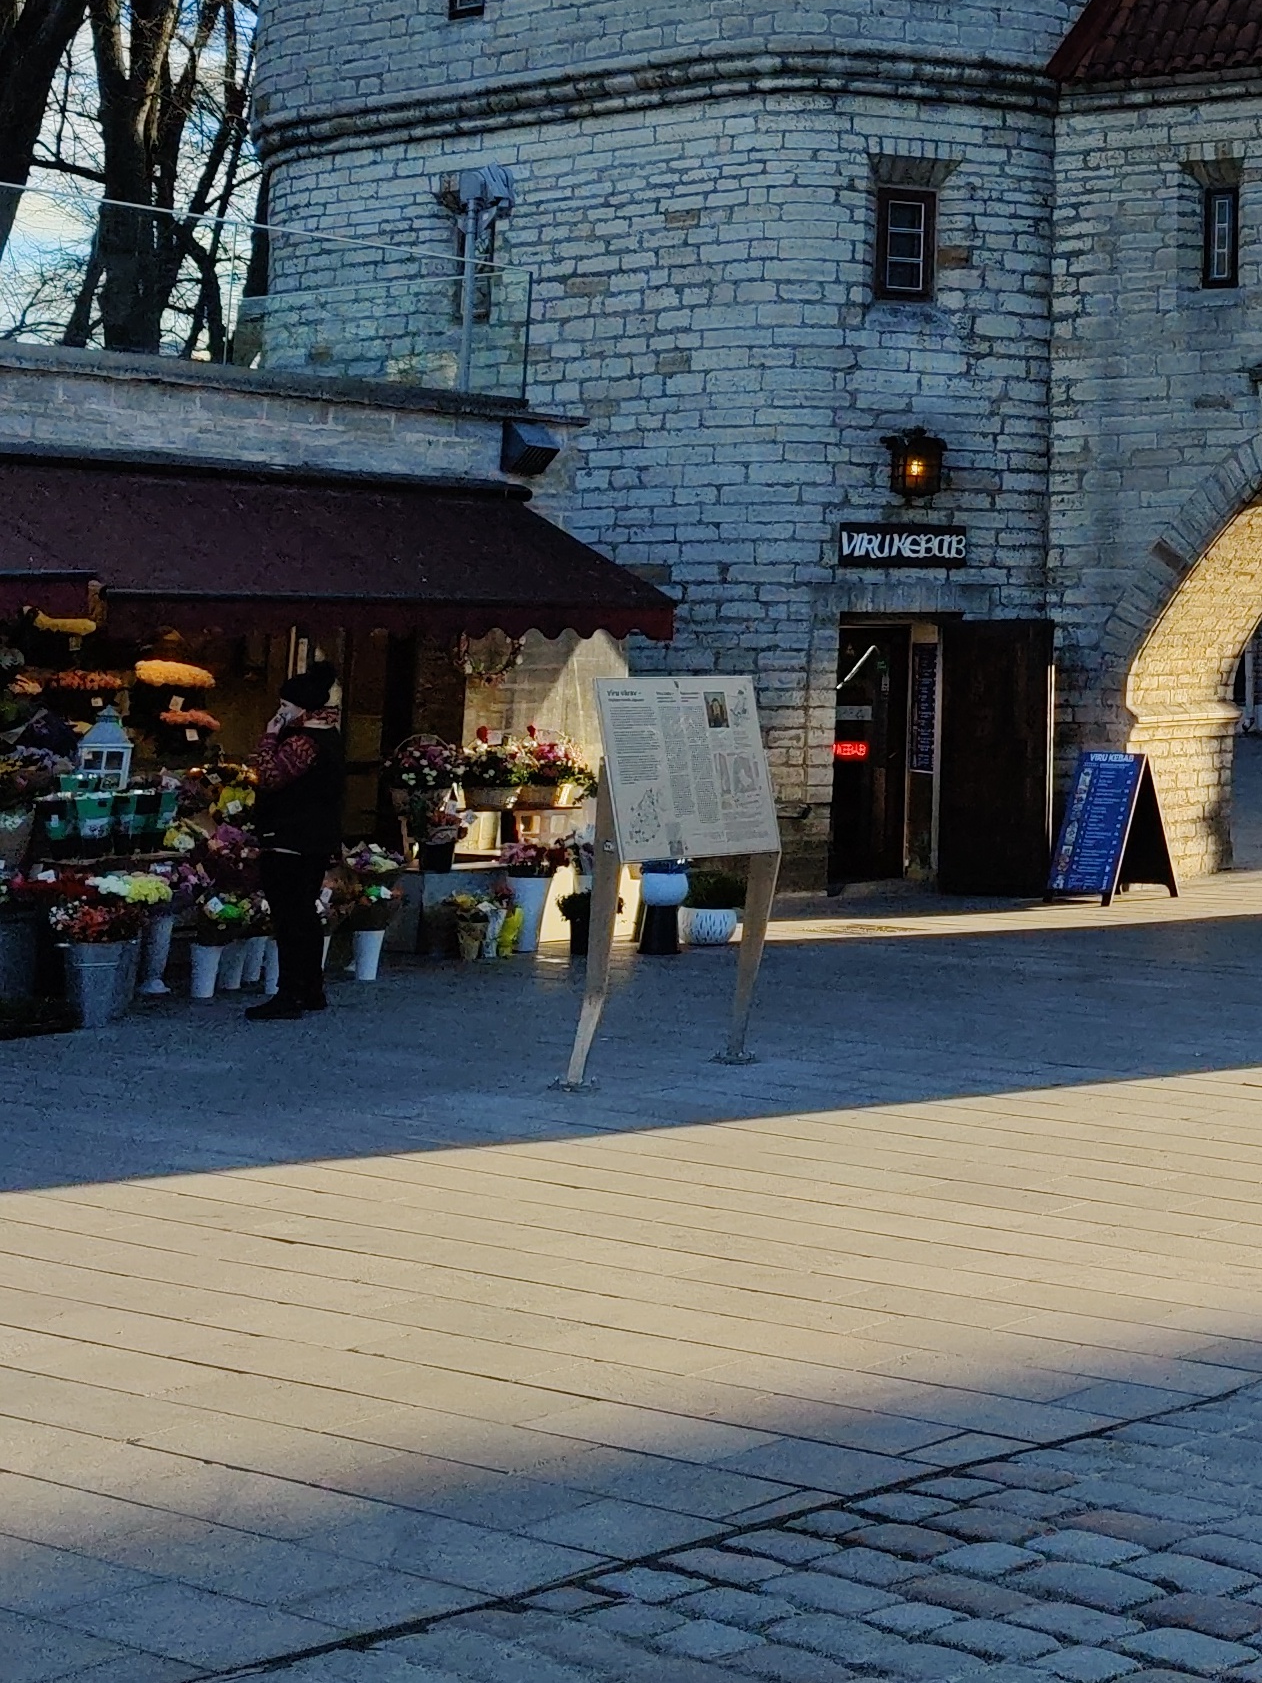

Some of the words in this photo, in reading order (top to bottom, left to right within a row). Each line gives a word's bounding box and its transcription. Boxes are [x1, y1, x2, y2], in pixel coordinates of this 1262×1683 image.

[841, 531, 890, 558] VIRU
[890, 532, 966, 558] KEBAB
[1090, 753, 1108, 762] VIRU
[1108, 753, 1134, 763] KEBAB
